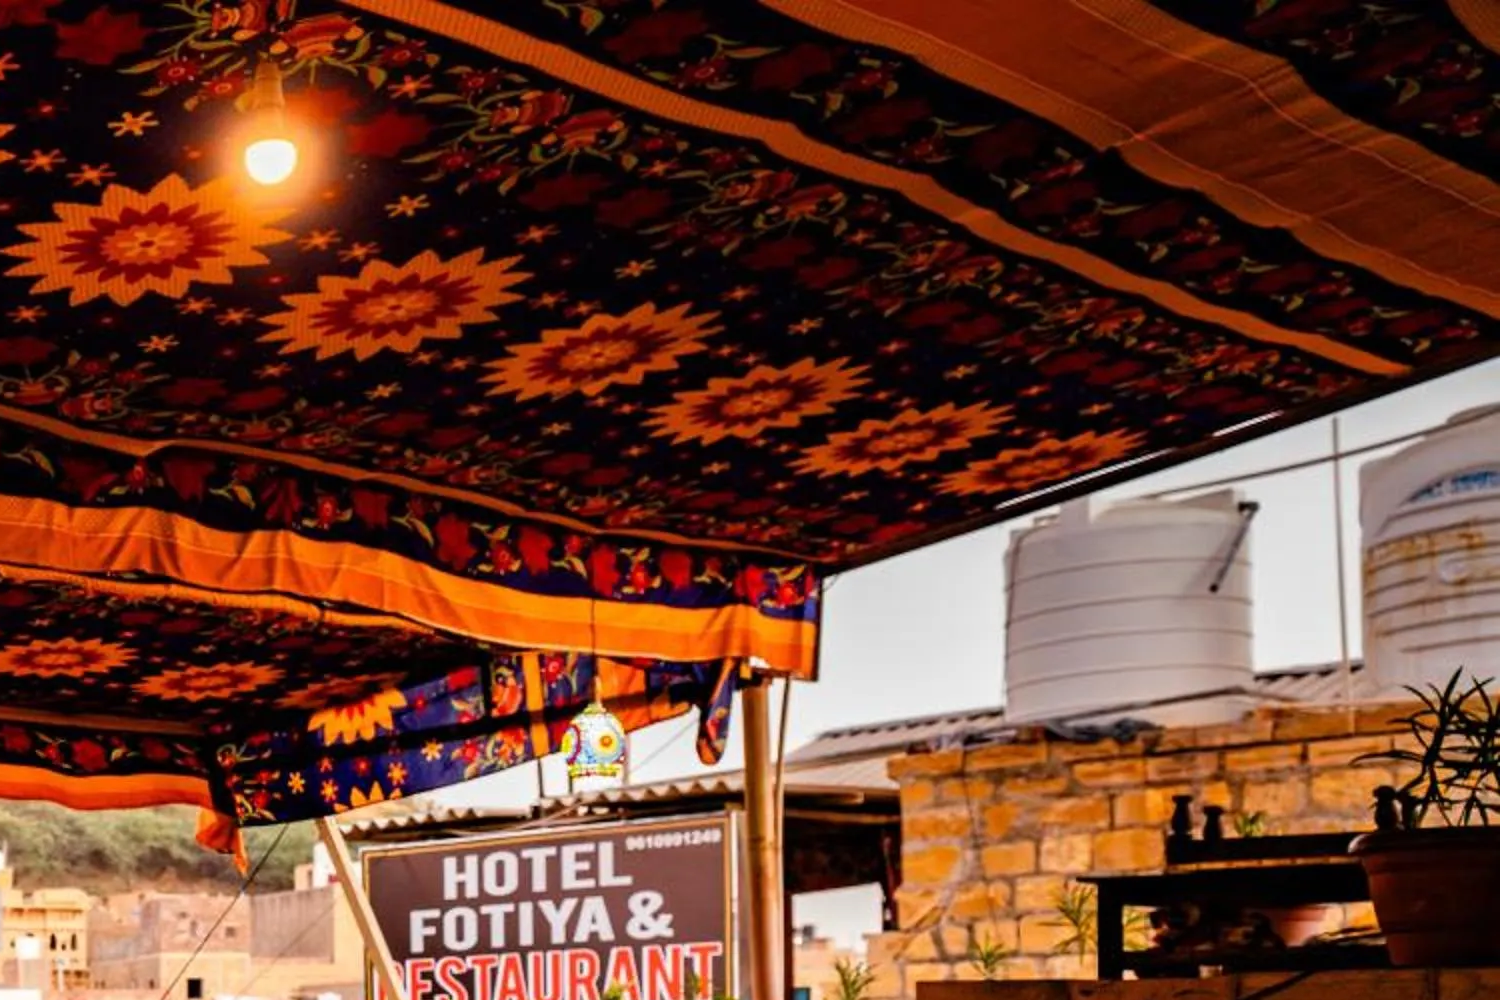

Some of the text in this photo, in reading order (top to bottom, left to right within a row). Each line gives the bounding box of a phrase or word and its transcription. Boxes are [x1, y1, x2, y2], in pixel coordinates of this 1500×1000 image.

[443, 841, 633, 900] HOTEL
[409, 890, 675, 954] FOTIYA &
